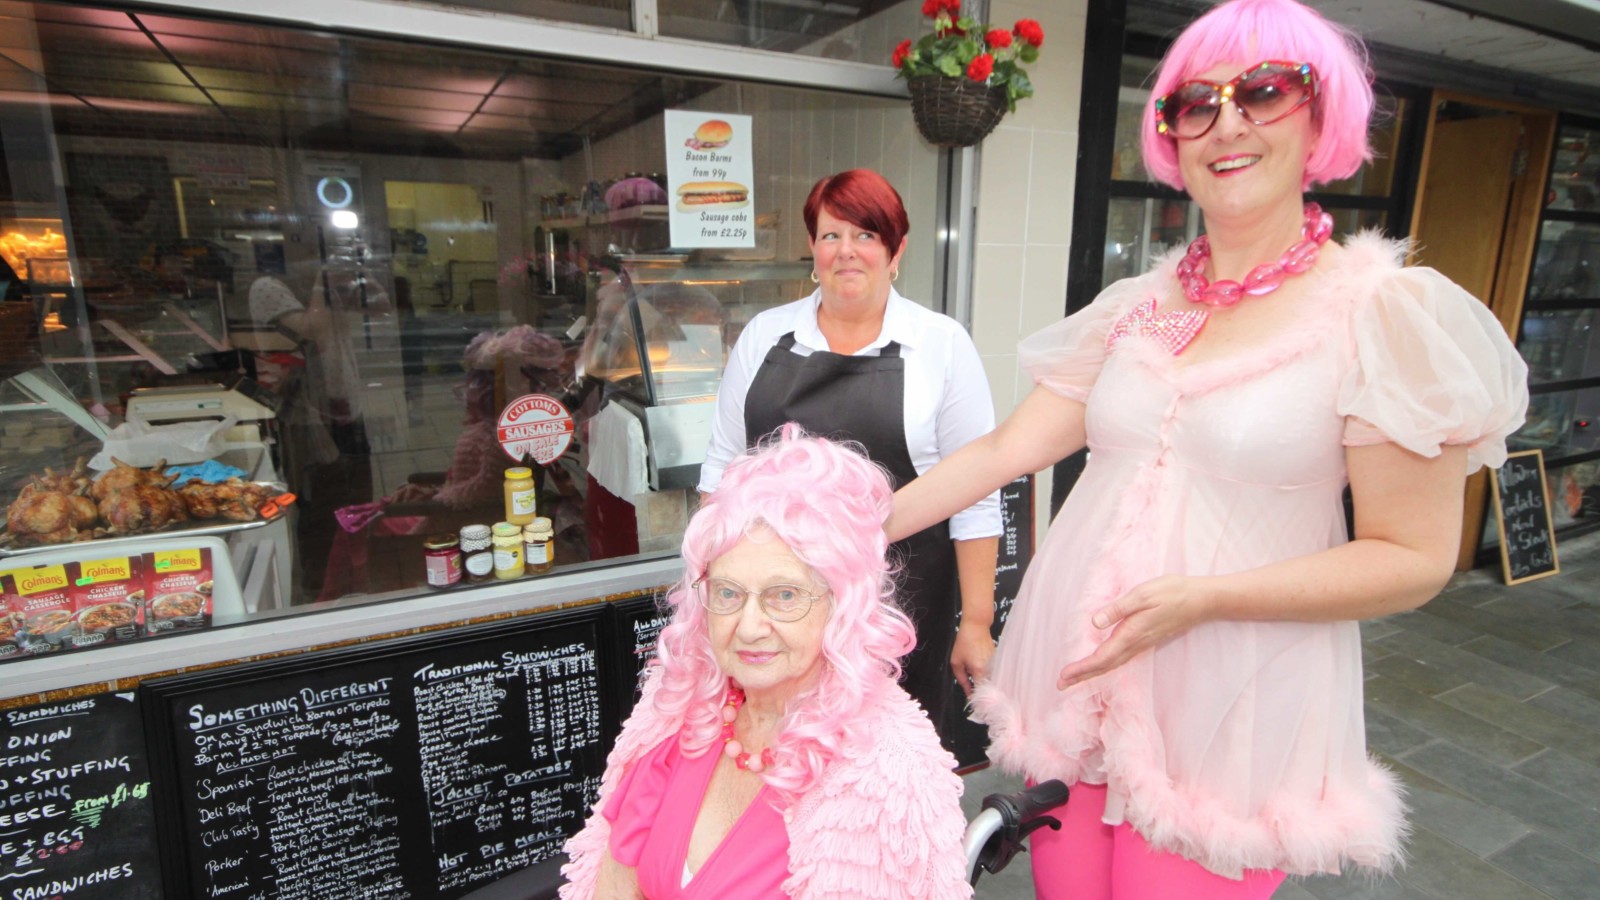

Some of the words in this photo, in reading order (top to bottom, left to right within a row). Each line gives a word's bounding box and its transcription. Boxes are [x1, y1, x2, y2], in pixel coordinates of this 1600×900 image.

[685, 151, 708, 161] Bacon
[709, 152, 732, 162] Barms
[692, 167, 709, 177] from
[712, 168, 727, 180] 99p
[700, 211, 729, 224] Sausage
[731, 213, 747, 222] cobs
[701, 227, 718, 237] from
[720, 227, 748, 239] £2.25p
[505, 421, 566, 440] SAUSAGES
[513, 442, 531, 456] ON
[21, 574, 65, 591] Colman's
[160, 580, 198, 588] CHASSEUR
[163, 575, 196, 584] CHICKEN
[87, 590, 128, 600] CHASSEUR
[90, 585, 125, 594] CHICKEN
[24, 597, 71, 612] CASSEROLE
[27, 593, 65, 606] SAUSAGE
[633, 619, 650, 633] ALL
[650, 616, 668, 627] DAY
[413, 660, 498, 681] TRADITIONAL
[501, 642, 585, 666] SANDWICHES
[413, 686, 435, 697] Roast
[436, 681, 464, 692] Chicken
[442, 688, 468, 699] Turkey
[6, 698, 97, 723] SANDWICHES
[189, 696, 298, 730] SOMETHING
[300, 677, 393, 707] DIFFERENT
[195, 735, 217, 746] On
[235, 713, 304, 736] Sandwich
[306, 711, 335, 722] Barm
[336, 706, 348, 716] or
[348, 697, 390, 711] Torpedo
[417, 713, 439, 723] Roast
[7, 726, 72, 750] ONION
[200, 743, 213, 754] or
[219, 736, 247, 749] have
[252, 732, 262, 740] it
[267, 729, 279, 737] in
[444, 730, 464, 739] Tuna
[241, 752, 271, 765] MADE
[273, 745, 296, 758] HOT
[420, 742, 453, 755] Cheese
[194, 751, 234, 766] Barm
[441, 750, 469, 763] Mayo
[31, 755, 131, 785] STUFFING
[268, 765, 297, 780] Roast
[432, 781, 493, 806] JACKET
[504, 760, 572, 785] POTATOES
[268, 787, 310, 803] Topside
[270, 801, 292, 814] and
[298, 791, 328, 805] Mayo
[276, 810, 304, 824] Roast
[343, 810, 368, 821] Mayo
[270, 819, 303, 833] melted
[43, 826, 85, 846] EGG
[300, 833, 321, 847] Pork
[439, 852, 468, 870] HOT
[479, 842, 506, 857] PIE
[515, 825, 563, 847] MEALS
[271, 852, 289, 864] and
[276, 863, 300, 875] Roast
[12, 862, 133, 900] SANDWICHES
[280, 878, 310, 893] Norfolk
[312, 869, 341, 883] Turkey
